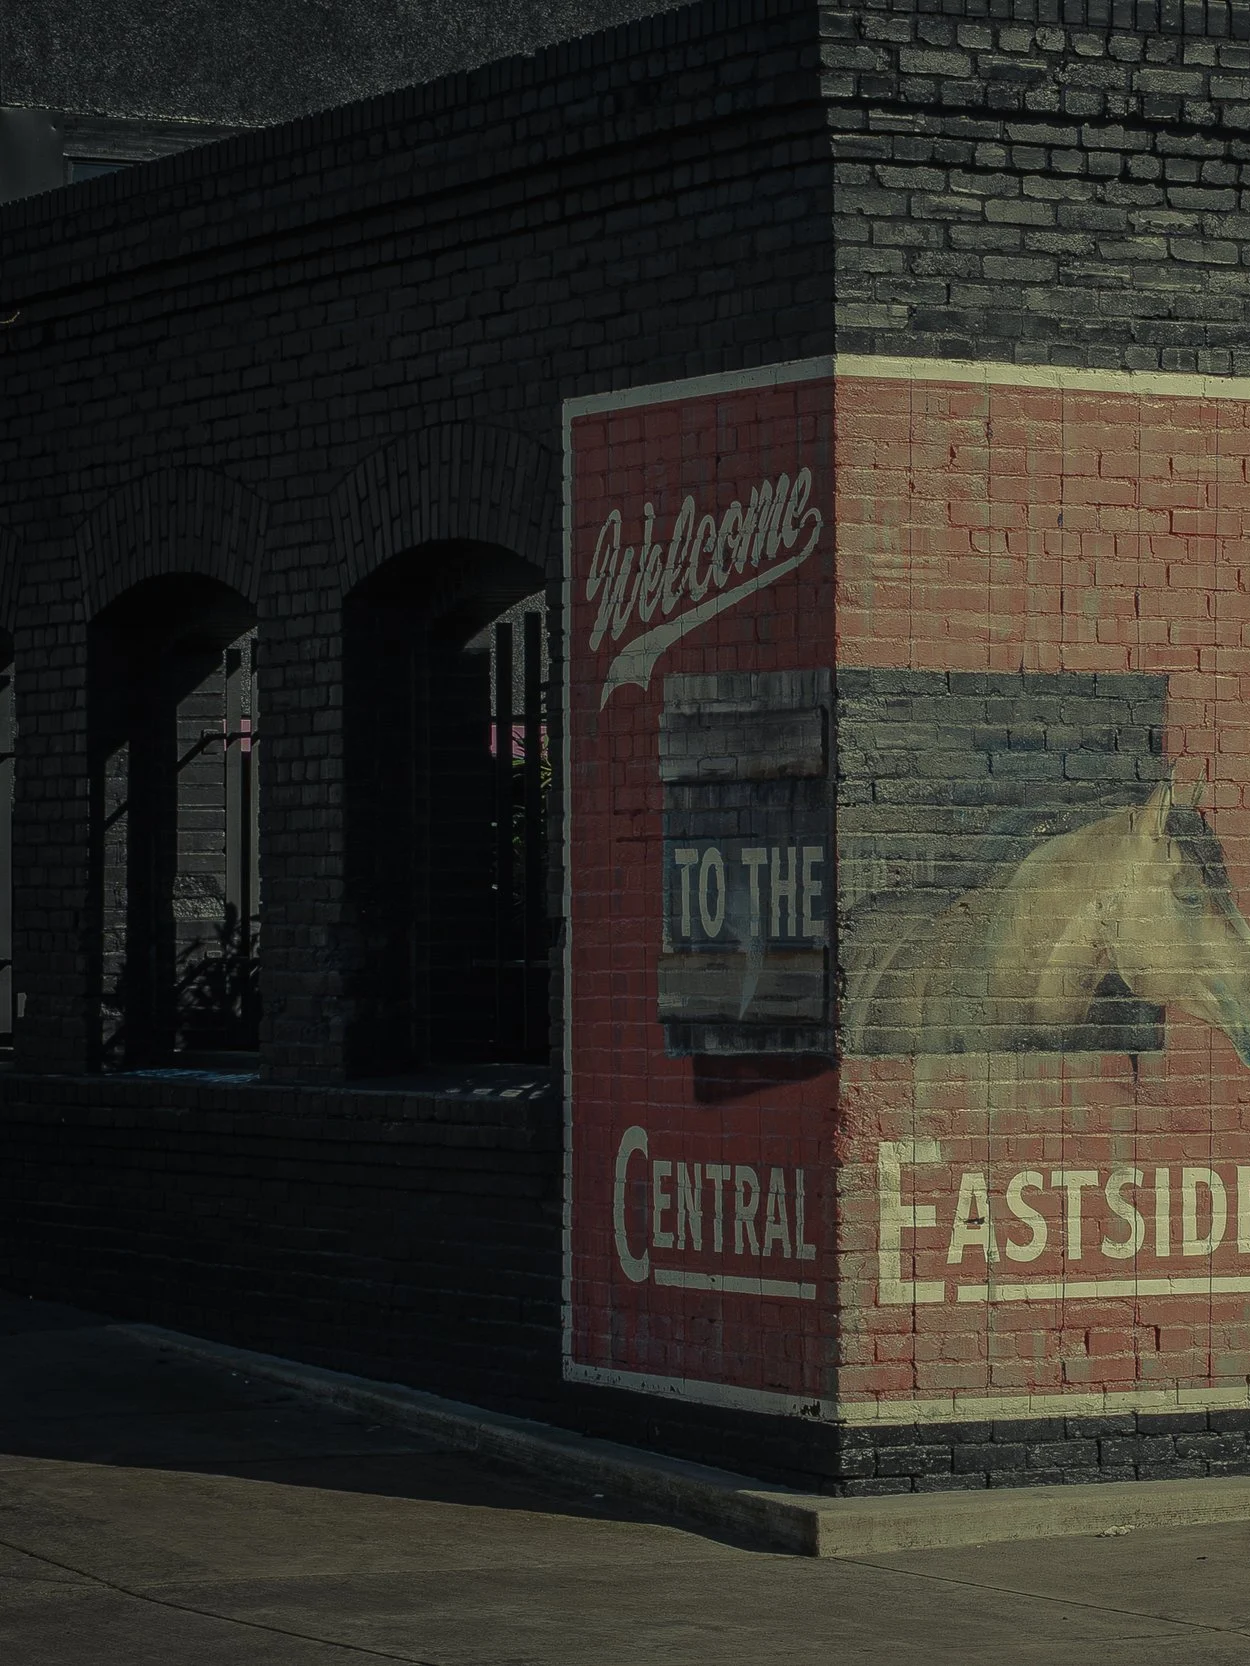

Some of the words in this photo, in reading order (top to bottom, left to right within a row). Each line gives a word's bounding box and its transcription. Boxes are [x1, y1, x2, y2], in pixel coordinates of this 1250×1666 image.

[586, 467, 822, 651] Welcome
[674, 847, 725, 938] TO
[741, 846, 825, 937] THE
